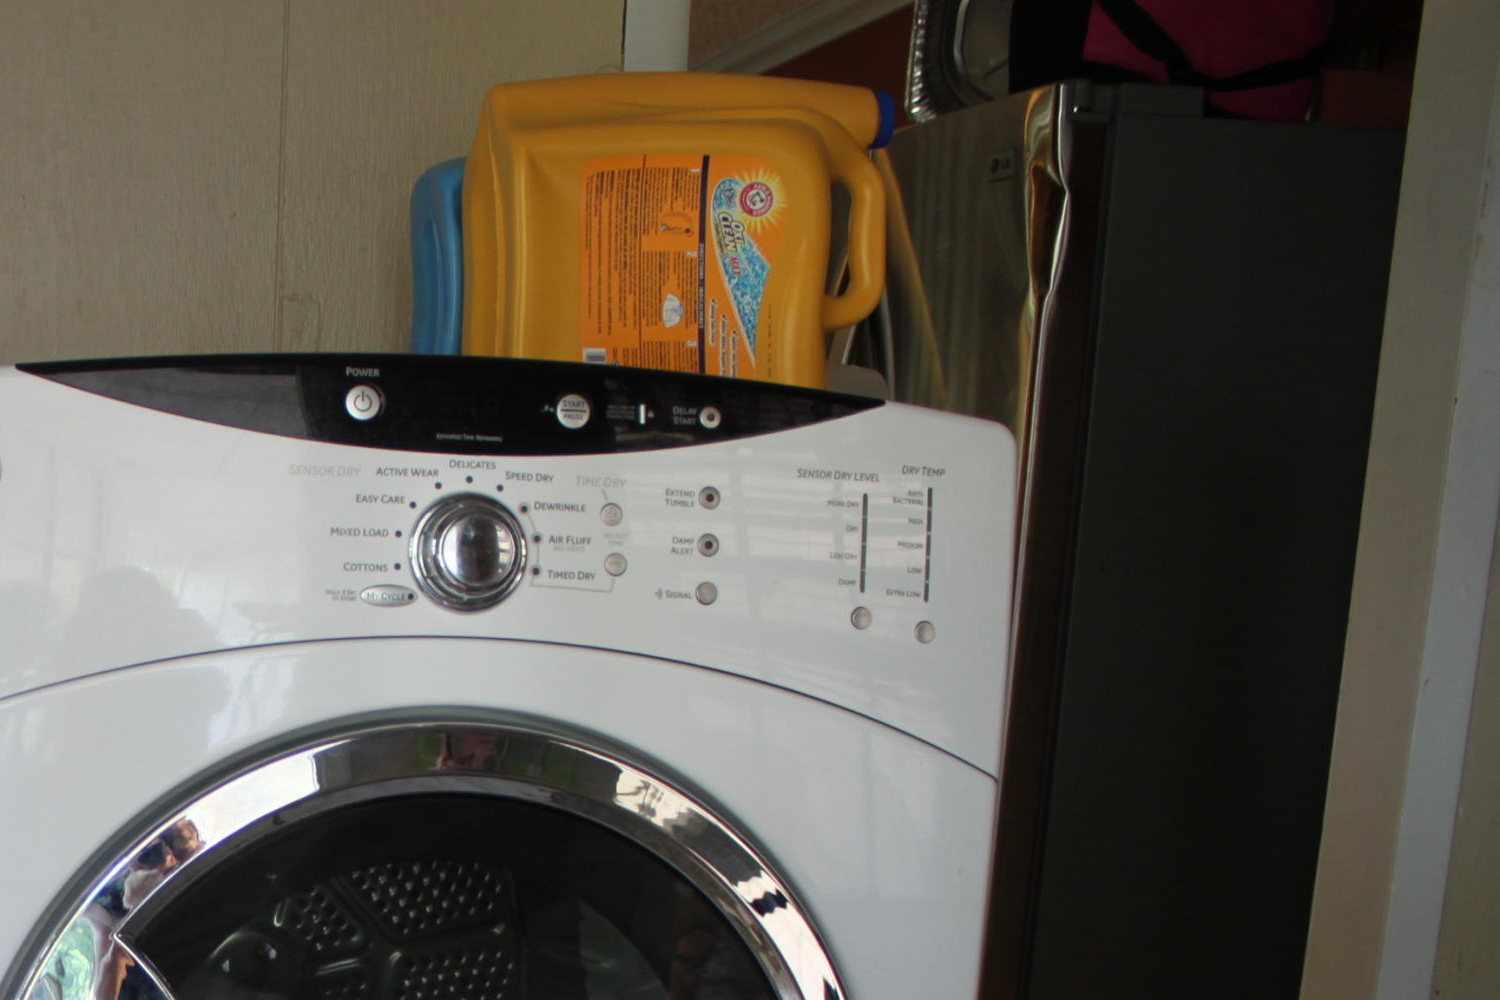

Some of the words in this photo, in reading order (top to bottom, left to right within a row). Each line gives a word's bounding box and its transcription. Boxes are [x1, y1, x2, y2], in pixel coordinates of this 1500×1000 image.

[718, 212, 737, 253] CLEAN
[346, 367, 380, 377] POWER
[562, 400, 586, 408] START
[673, 406, 697, 415] DELAY
[673, 416, 697, 425] START
[449, 459, 496, 470] DELICATES
[289, 463, 334, 476] SENSOR
[336, 464, 361, 477] DRY
[376, 467, 408, 477] ACTIVE
[411, 468, 439, 478] WEAR
[902, 464, 920, 476] DRY
[921, 465, 946, 478] TEMP
[505, 471, 532, 481] SPEED
[534, 472, 554, 483] DRY
[797, 468, 833, 481] SENSOR
[834, 470, 853, 482] DRY
[854, 471, 880, 483] LEVEL
[575, 475, 598, 487] TIME
[601, 476, 627, 488] DRY
[665, 488, 695, 498] EXTEND
[356, 494, 379, 504] EASY
[381, 494, 405, 504] CARE
[665, 498, 695, 508] TUMBLE
[534, 501, 586, 513] DEWRINKLE
[330, 527, 359, 537] MIXED
[362, 527, 389, 538] LOAD
[846, 524, 859, 533] DRY
[548, 535, 564, 545] AIR
[566, 535, 592, 546] FLUFF
[672, 536, 694, 546] DAMP
[671, 546, 693, 556] ALERT
[343, 562, 388, 572] COTTONS
[907, 566, 922, 574] LOW
[548, 570, 575, 580] TIMED
[577, 571, 596, 581] DRY
[367, 591, 379, 600] MY
[382, 592, 406, 601] CYCLE
[665, 590, 692, 600] SIGNAL
